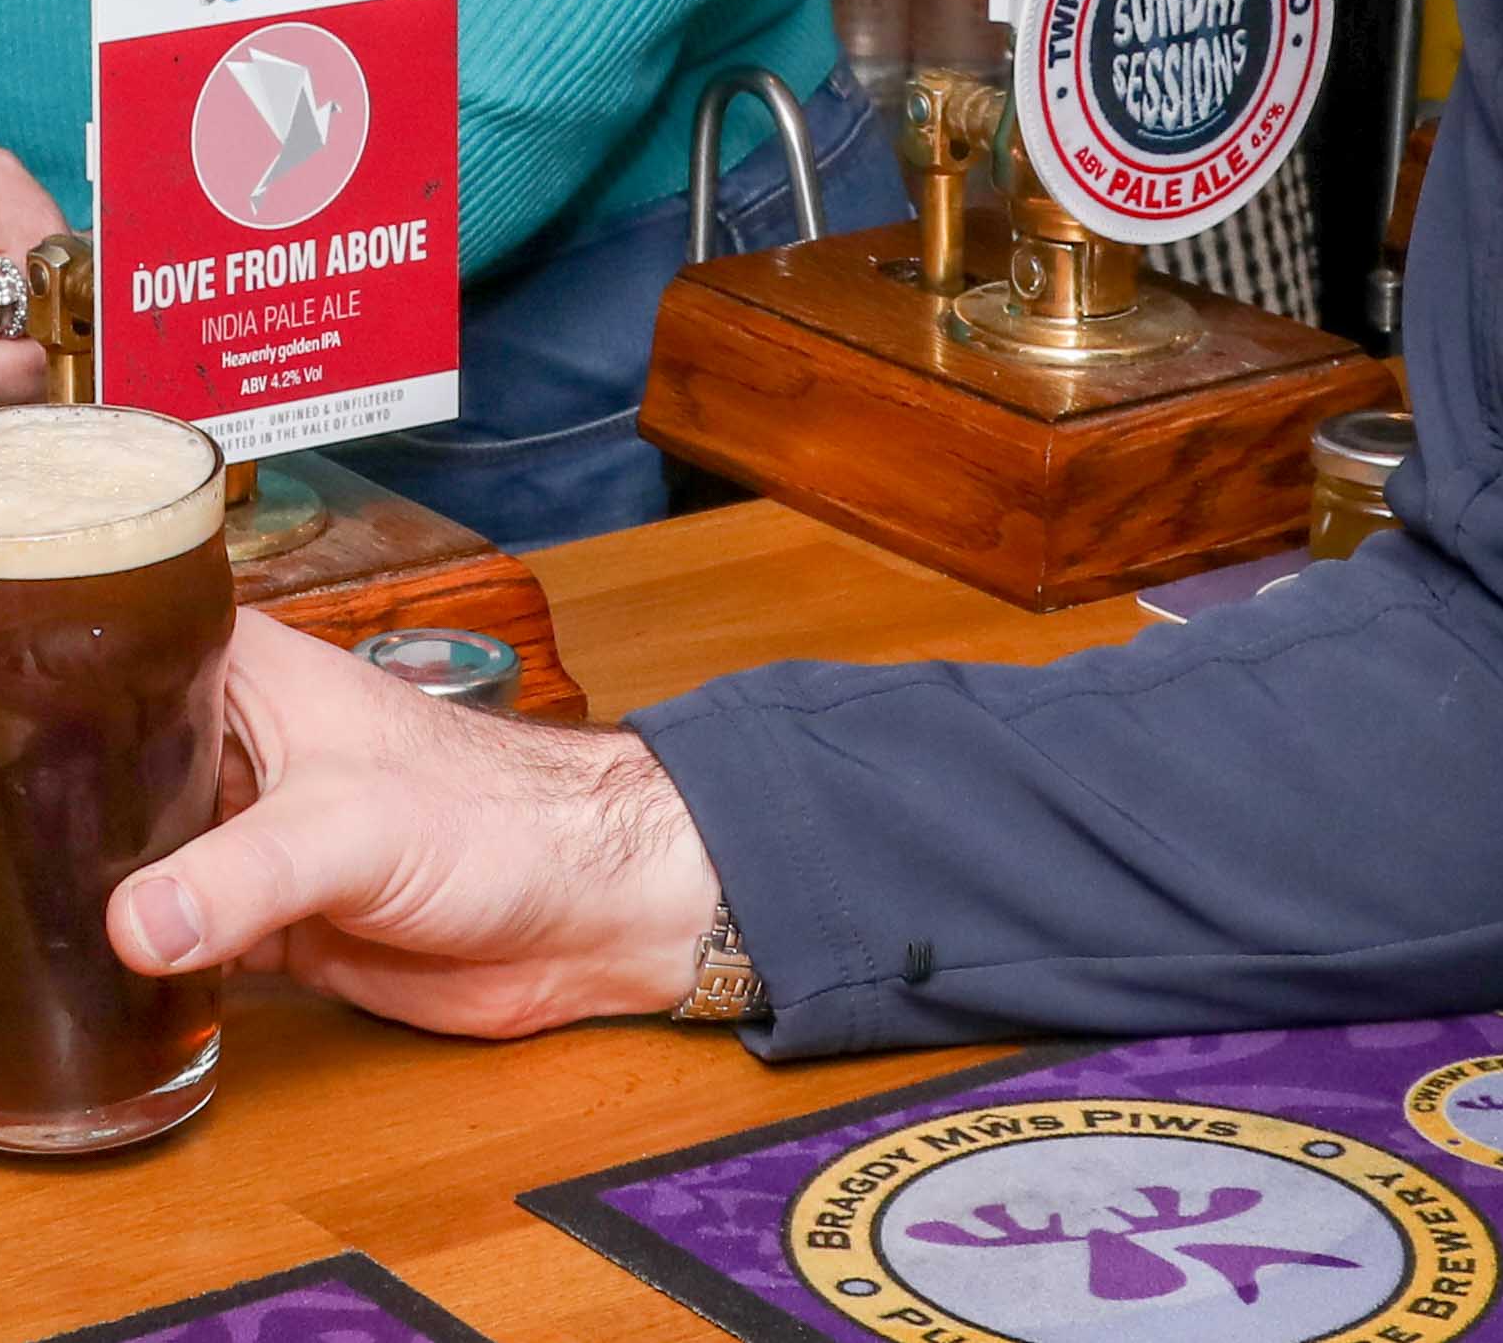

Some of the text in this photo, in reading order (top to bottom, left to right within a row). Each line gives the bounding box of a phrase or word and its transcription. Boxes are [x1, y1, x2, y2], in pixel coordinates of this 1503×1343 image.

[1111, 27, 1249, 133] SESSIONS
[1073, 100, 1287, 211] ABV PALE ALE 4.5%
[131, 218, 428, 314] DOVE FROM ABOVE
[201, 288, 363, 347] INDIA PALE ALE
[221, 329, 342, 370] Heavenly golden IPA
[240, 365, 324, 396] ABV 4.2% Vol
[269, 387, 405, 426] UNFINED UNFILTERED
[1410, 1060, 1467, 1115] CWRW
[804, 1107, 1242, 1254] BRAGDY PIWS
[1363, 1170, 1477, 1321] BREWERY
